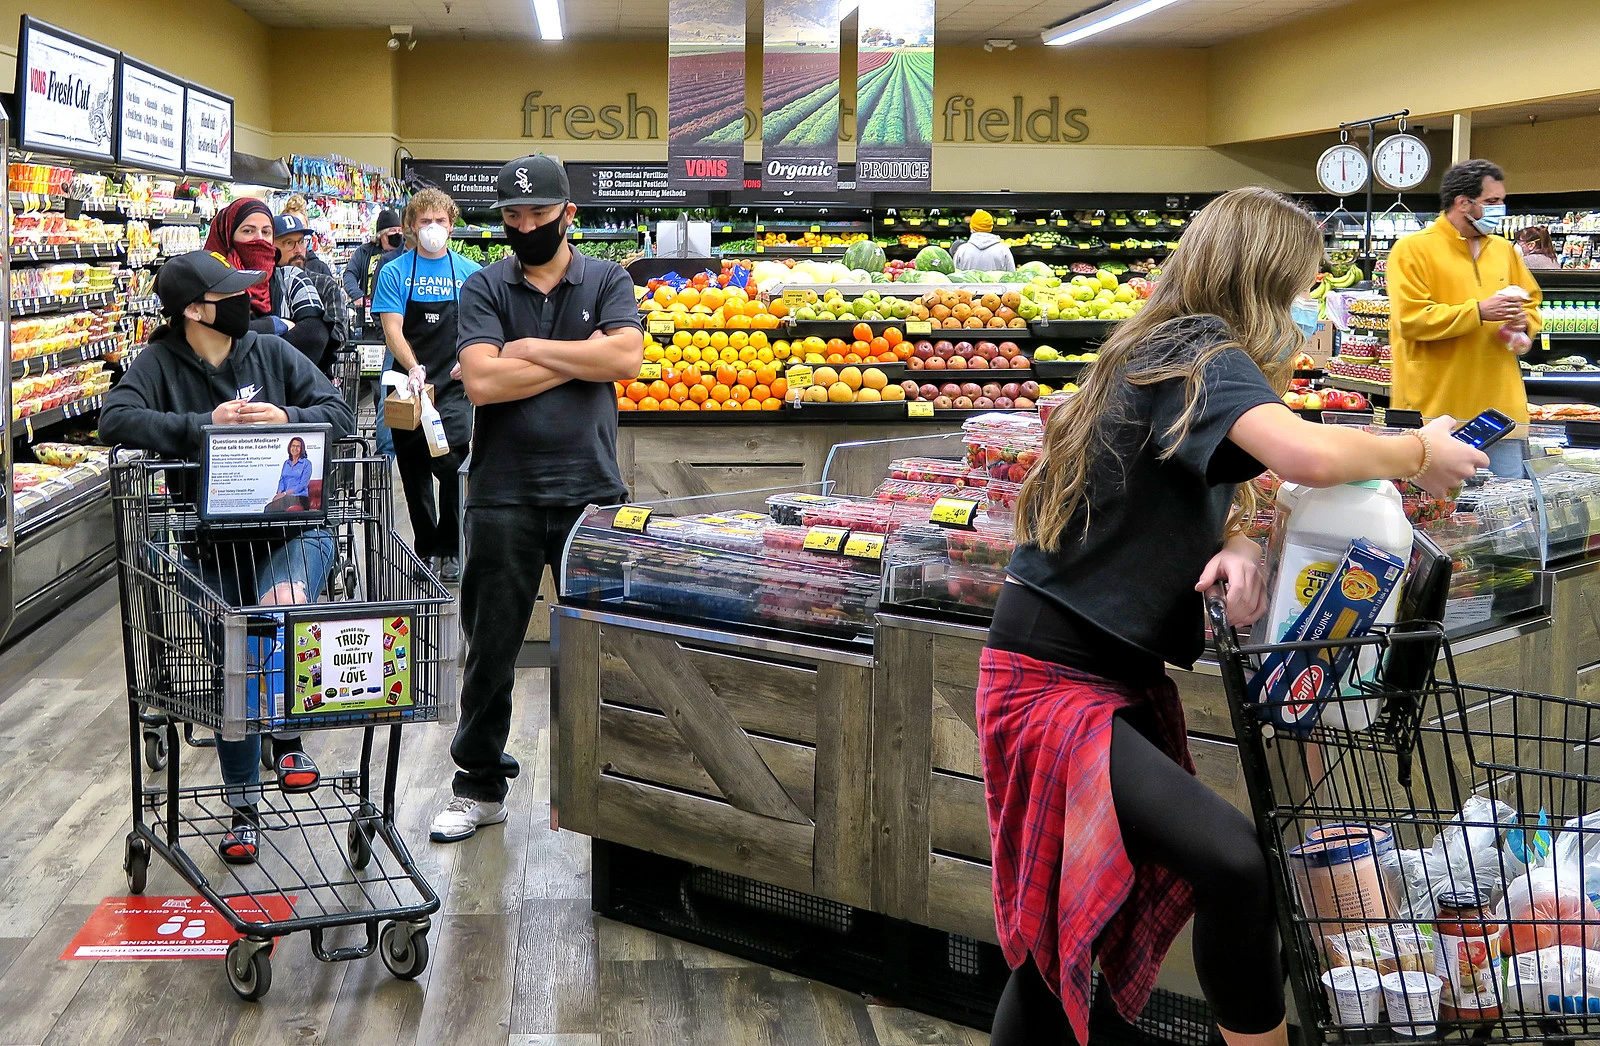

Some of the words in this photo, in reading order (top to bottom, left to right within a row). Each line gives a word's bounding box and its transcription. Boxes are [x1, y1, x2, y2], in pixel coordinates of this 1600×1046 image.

[30, 67, 46, 96] VONS
[47, 70, 72, 106] Fresh
[75, 78, 90, 110] Cut
[521, 91, 659, 140] fresh
[942, 95, 1090, 142] fields
[598, 170, 613, 178] NO
[685, 160, 728, 177] VONS
[767, 160, 833, 179] Organic
[860, 162, 930, 178] PRODUCE
[445, 174, 467, 182] Picked
[478, 174, 489, 182] the
[598, 180, 614, 188] NO
[743, 180, 762, 188] VONS
[837, 182, 856, 190] PRODU
[635, 190, 660, 198] Farming
[283, 215, 296, 229] D
[405, 276, 464, 288] CLEANING
[418, 286, 452, 296] CREW
[1307, 576, 1326, 588] TI
[1311, 610, 1333, 641] NGUINE
[274, 640, 284, 652] 2
[335, 634, 370, 647] TRUST
[334, 652, 373, 666] QUALITY
[340, 670, 367, 683] LOVE
